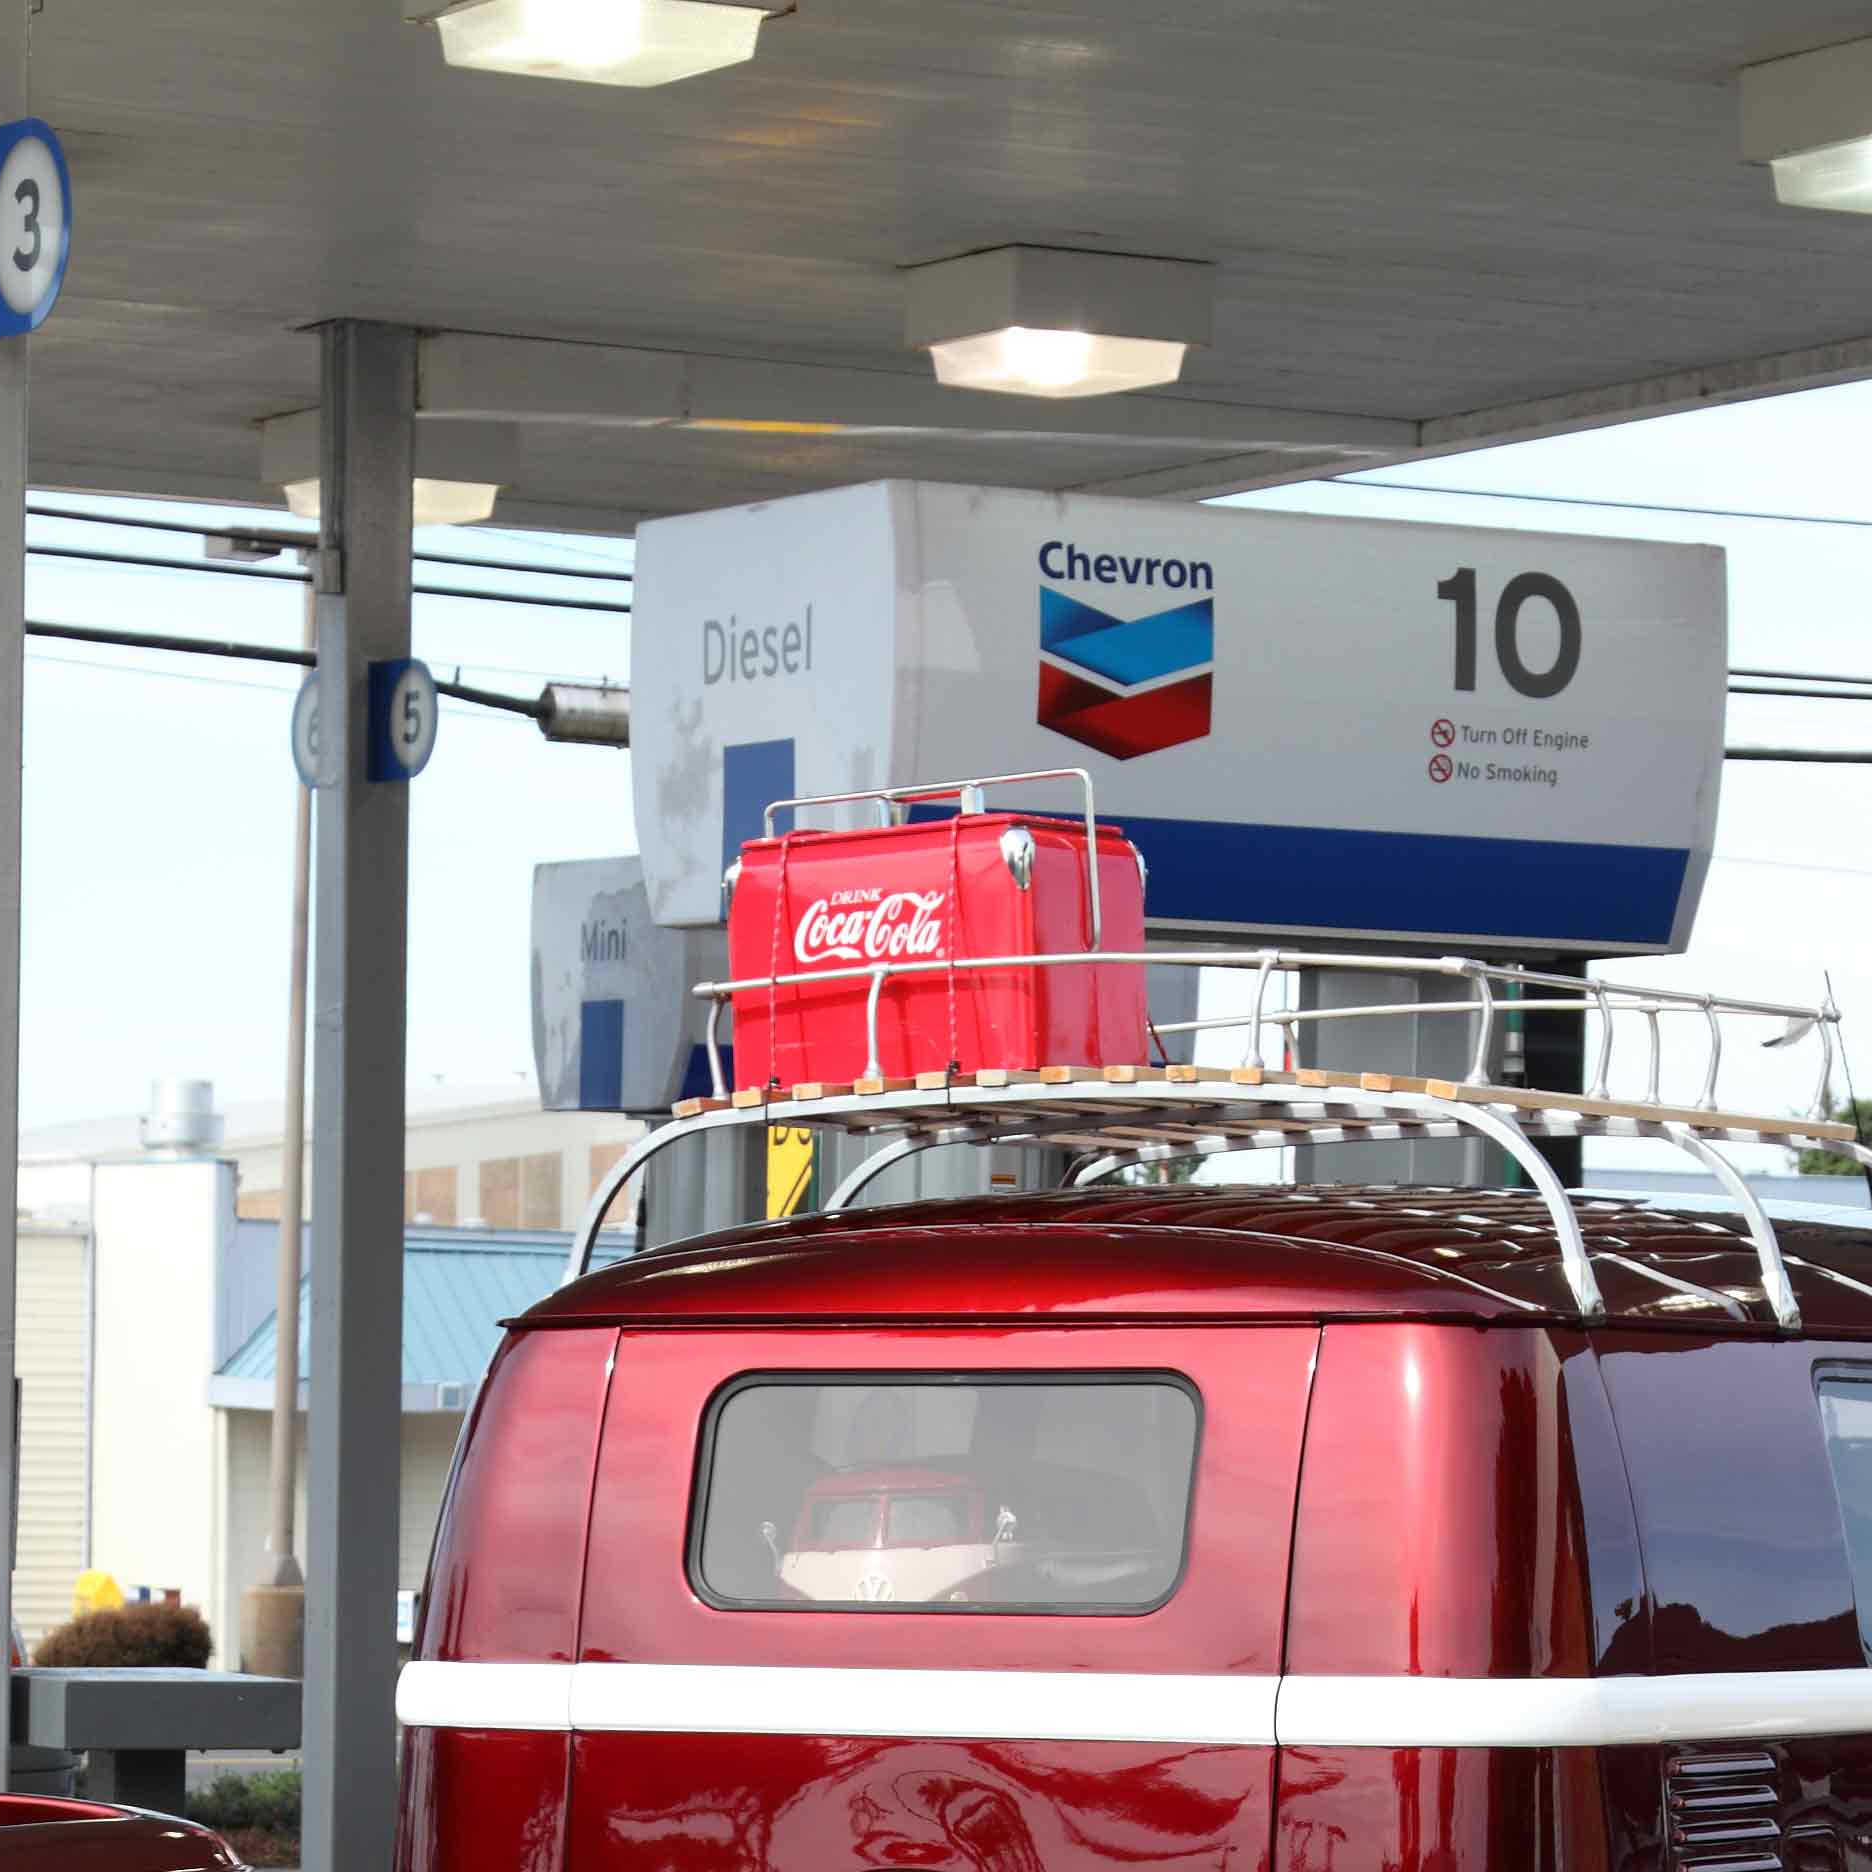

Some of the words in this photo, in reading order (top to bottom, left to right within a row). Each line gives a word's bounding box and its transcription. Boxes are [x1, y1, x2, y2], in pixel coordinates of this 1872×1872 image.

[11, 177, 42, 272] 3
[1038, 540, 1214, 590] Chevron
[702, 602, 814, 686] Diesel
[1435, 566, 1583, 699] 10
[403, 690, 421, 744] 5
[1460, 725, 1499, 746] Turn
[1502, 727, 1528, 748] Off
[1531, 729, 1590, 753] Engine
[1456, 760, 1482, 781] No
[1485, 762, 1558, 788] Smoking
[830, 888, 884, 906] DRINK
[580, 919, 627, 963] Mini
[793, 890, 945, 964] Coca-Cola
